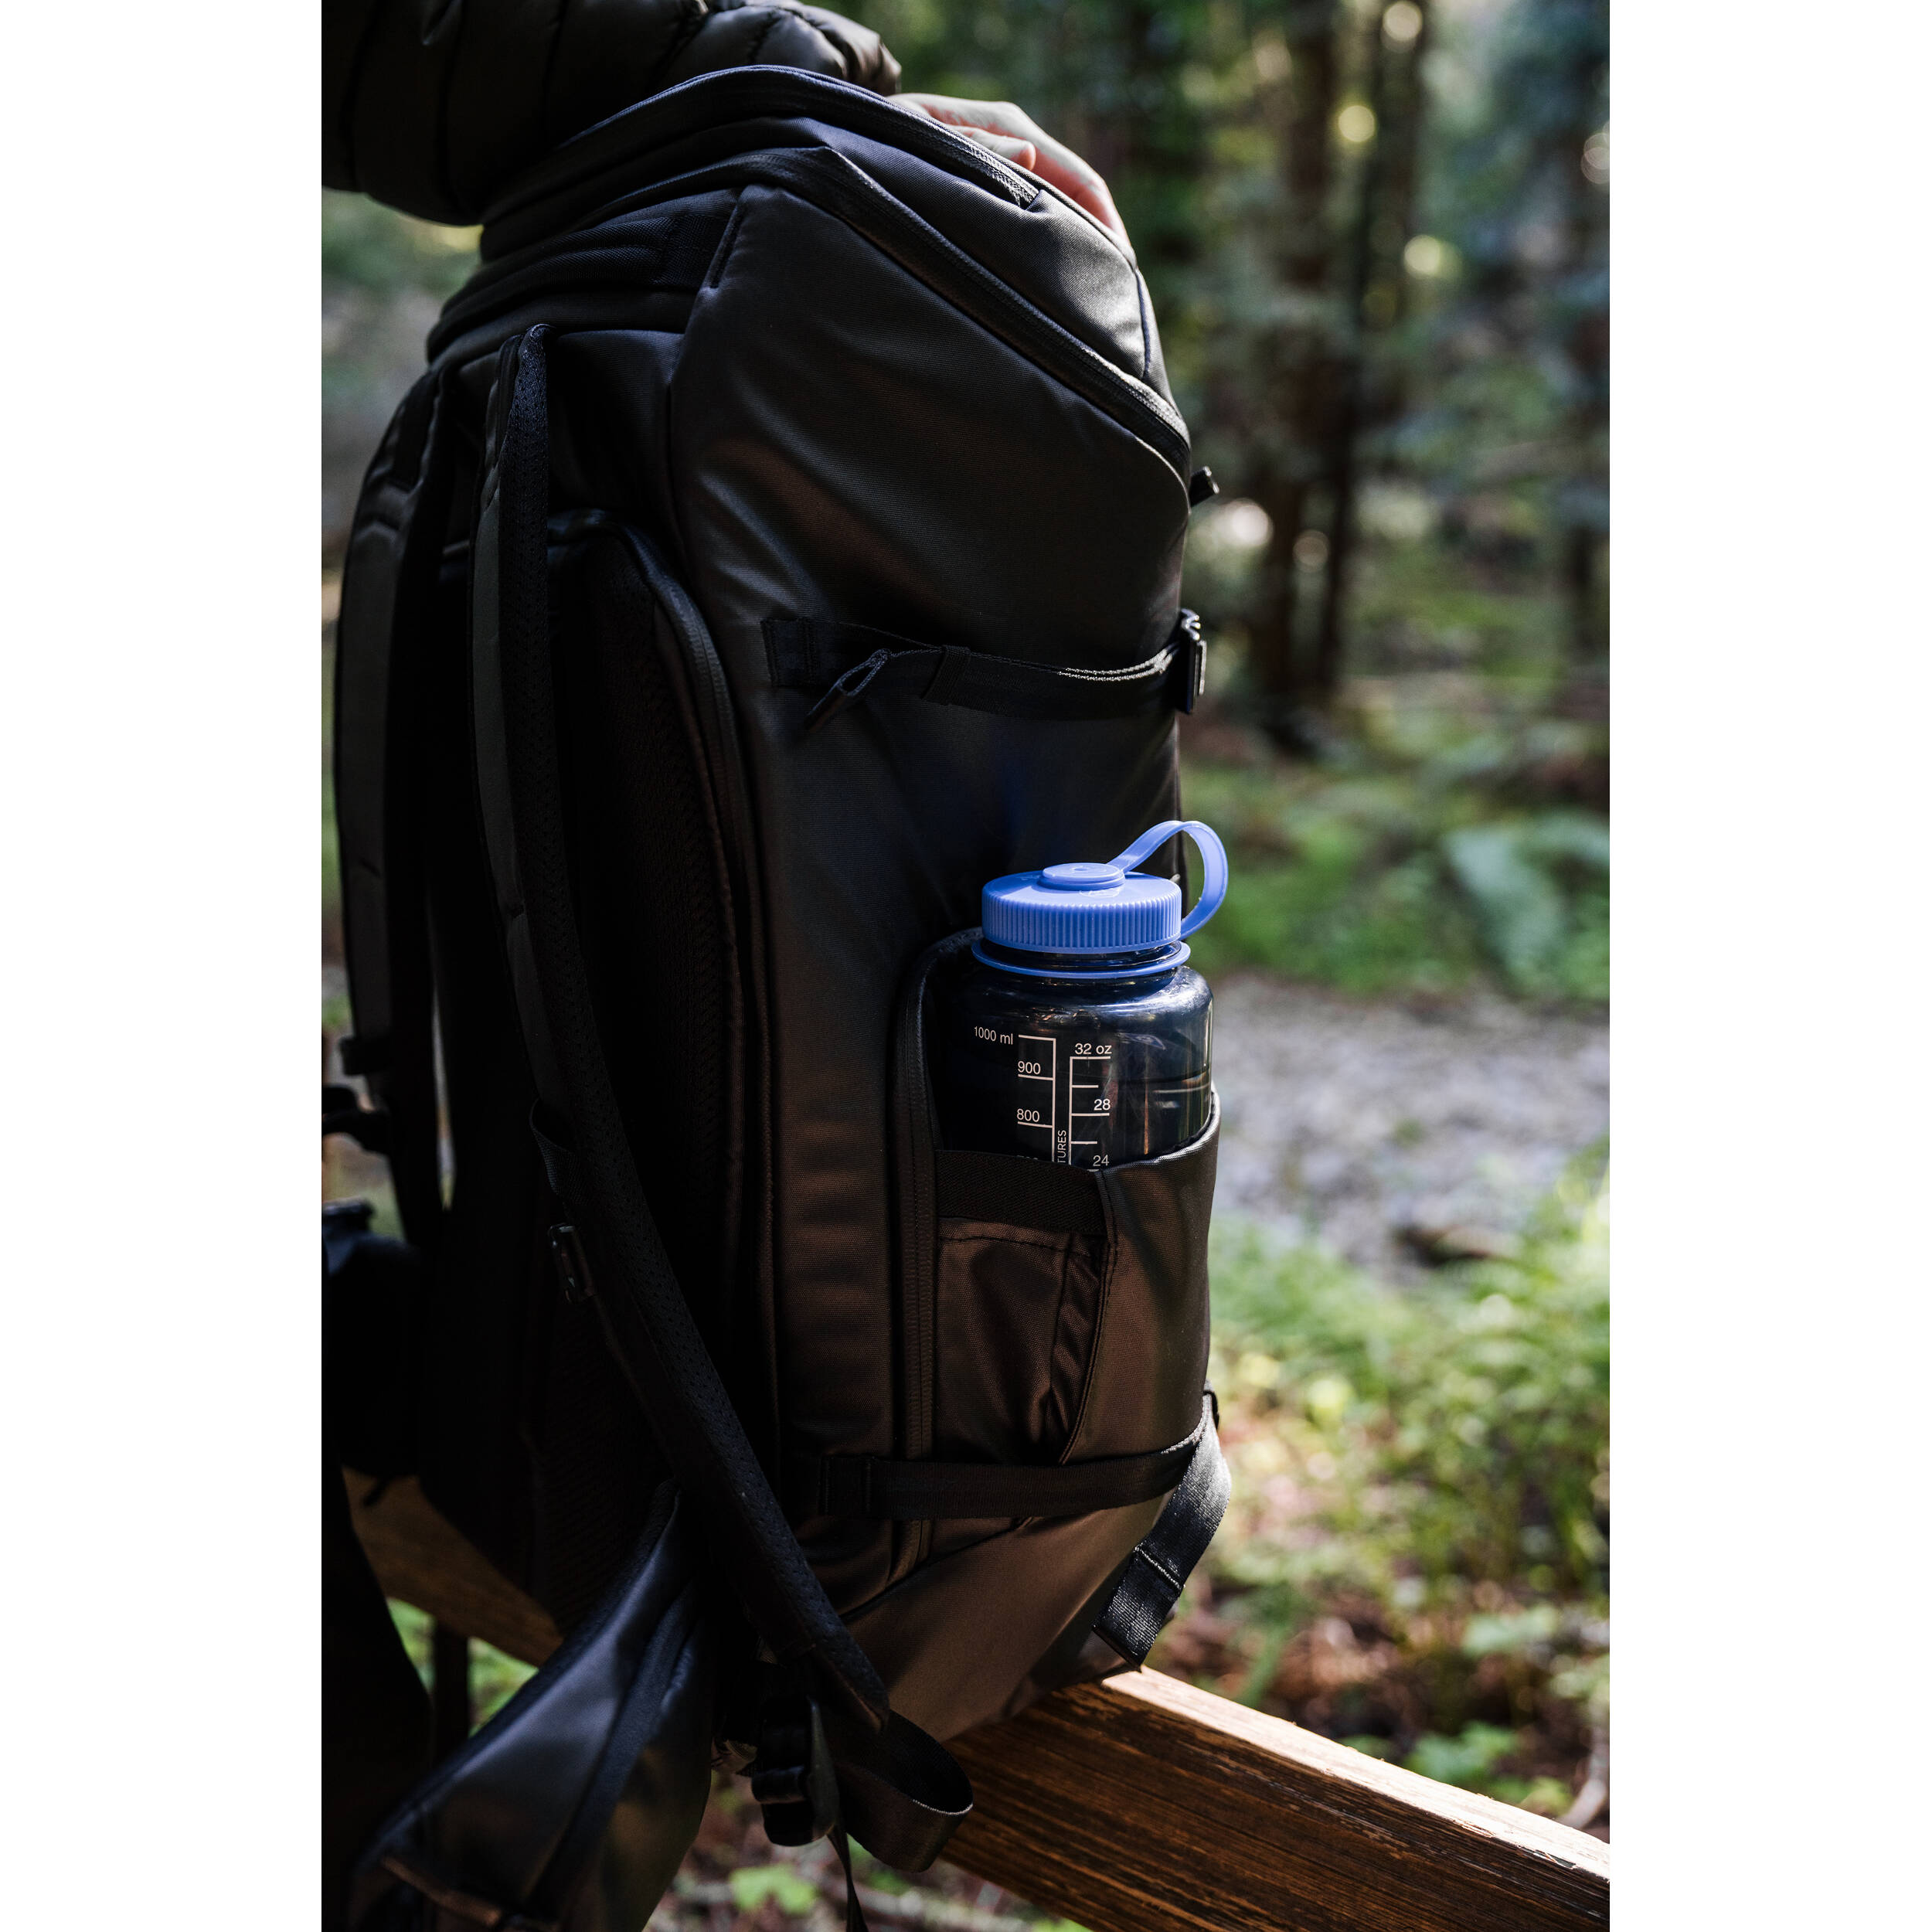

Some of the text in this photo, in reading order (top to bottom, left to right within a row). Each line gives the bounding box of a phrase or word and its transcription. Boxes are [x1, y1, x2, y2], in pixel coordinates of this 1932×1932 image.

[974, 1026, 1013, 1045] 1000 ml
[1074, 1043, 1112, 1055] 32 oz
[1017, 1060, 1041, 1075] 900
[1094, 1098, 1111, 1111] 28
[1016, 1108, 1040, 1122] 800
[1093, 1155, 1110, 1167] 24
